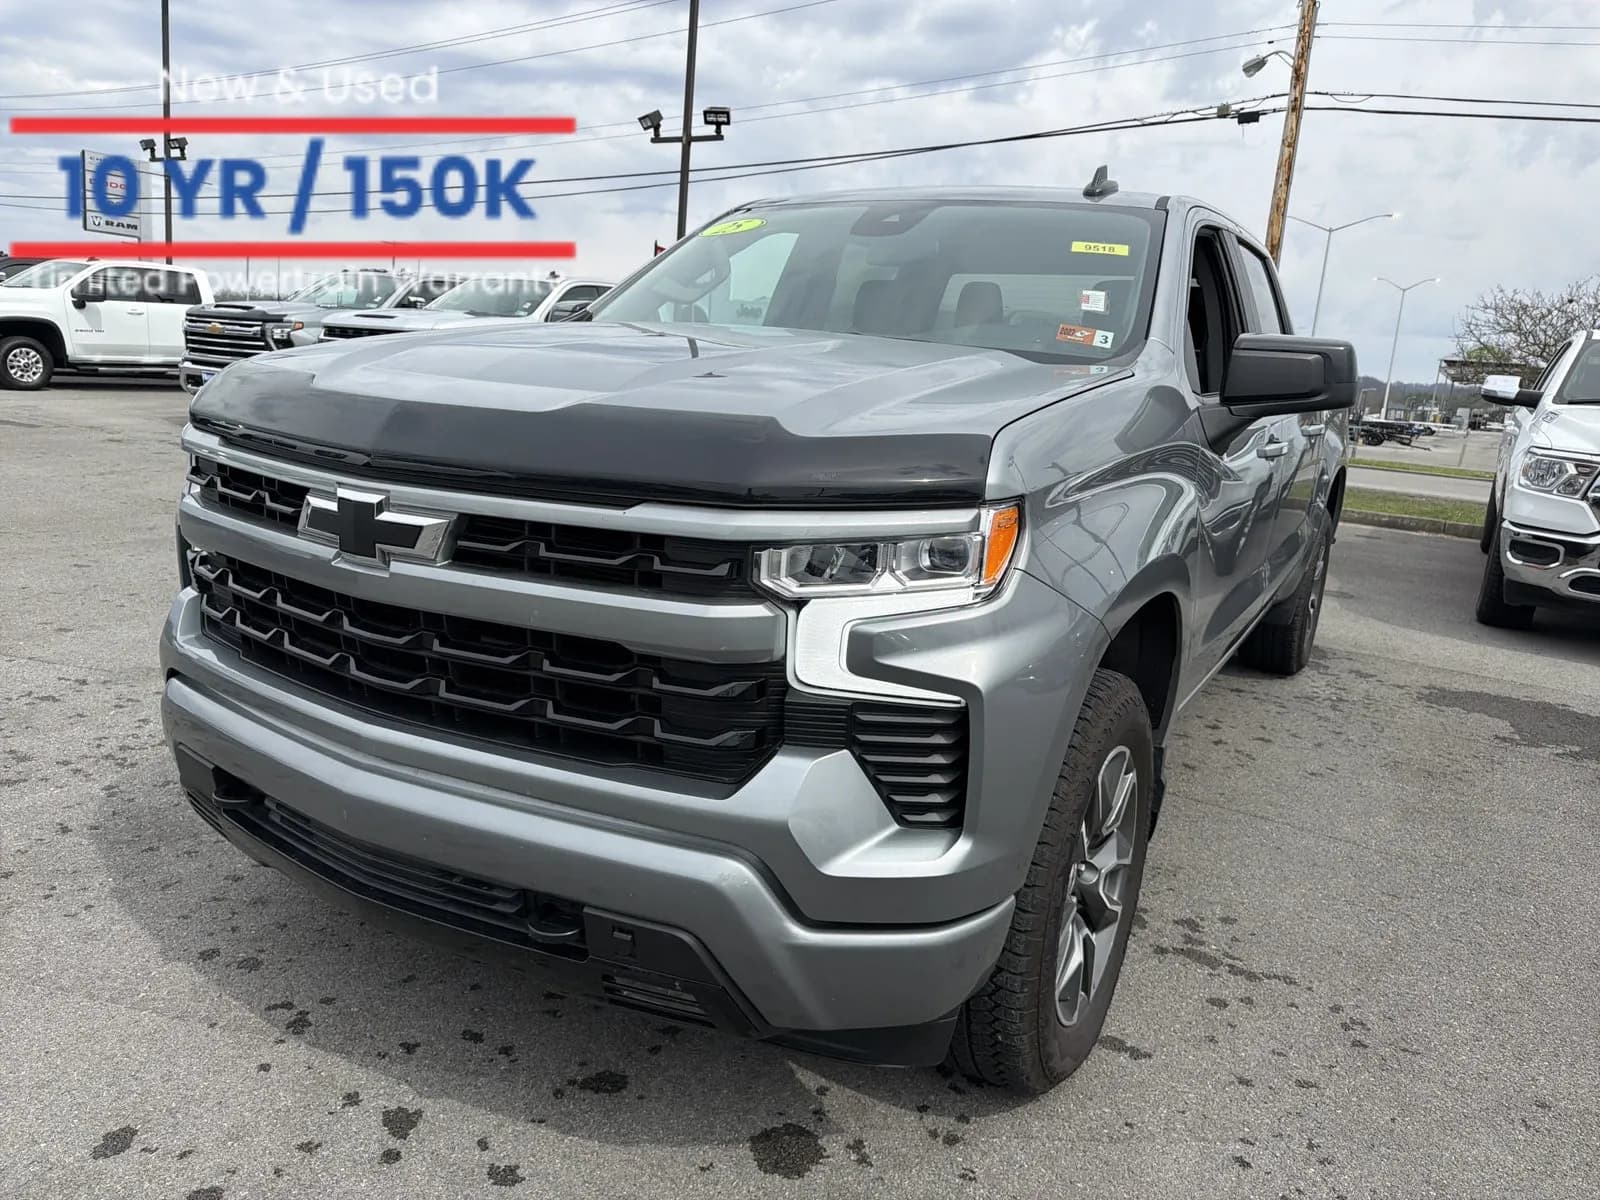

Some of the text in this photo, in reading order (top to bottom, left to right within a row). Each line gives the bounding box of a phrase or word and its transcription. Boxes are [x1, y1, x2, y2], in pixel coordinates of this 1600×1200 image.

[105, 219, 138, 231] RAM
[1084, 244, 1115, 253] 9518
[1099, 335, 1109, 345] 3
